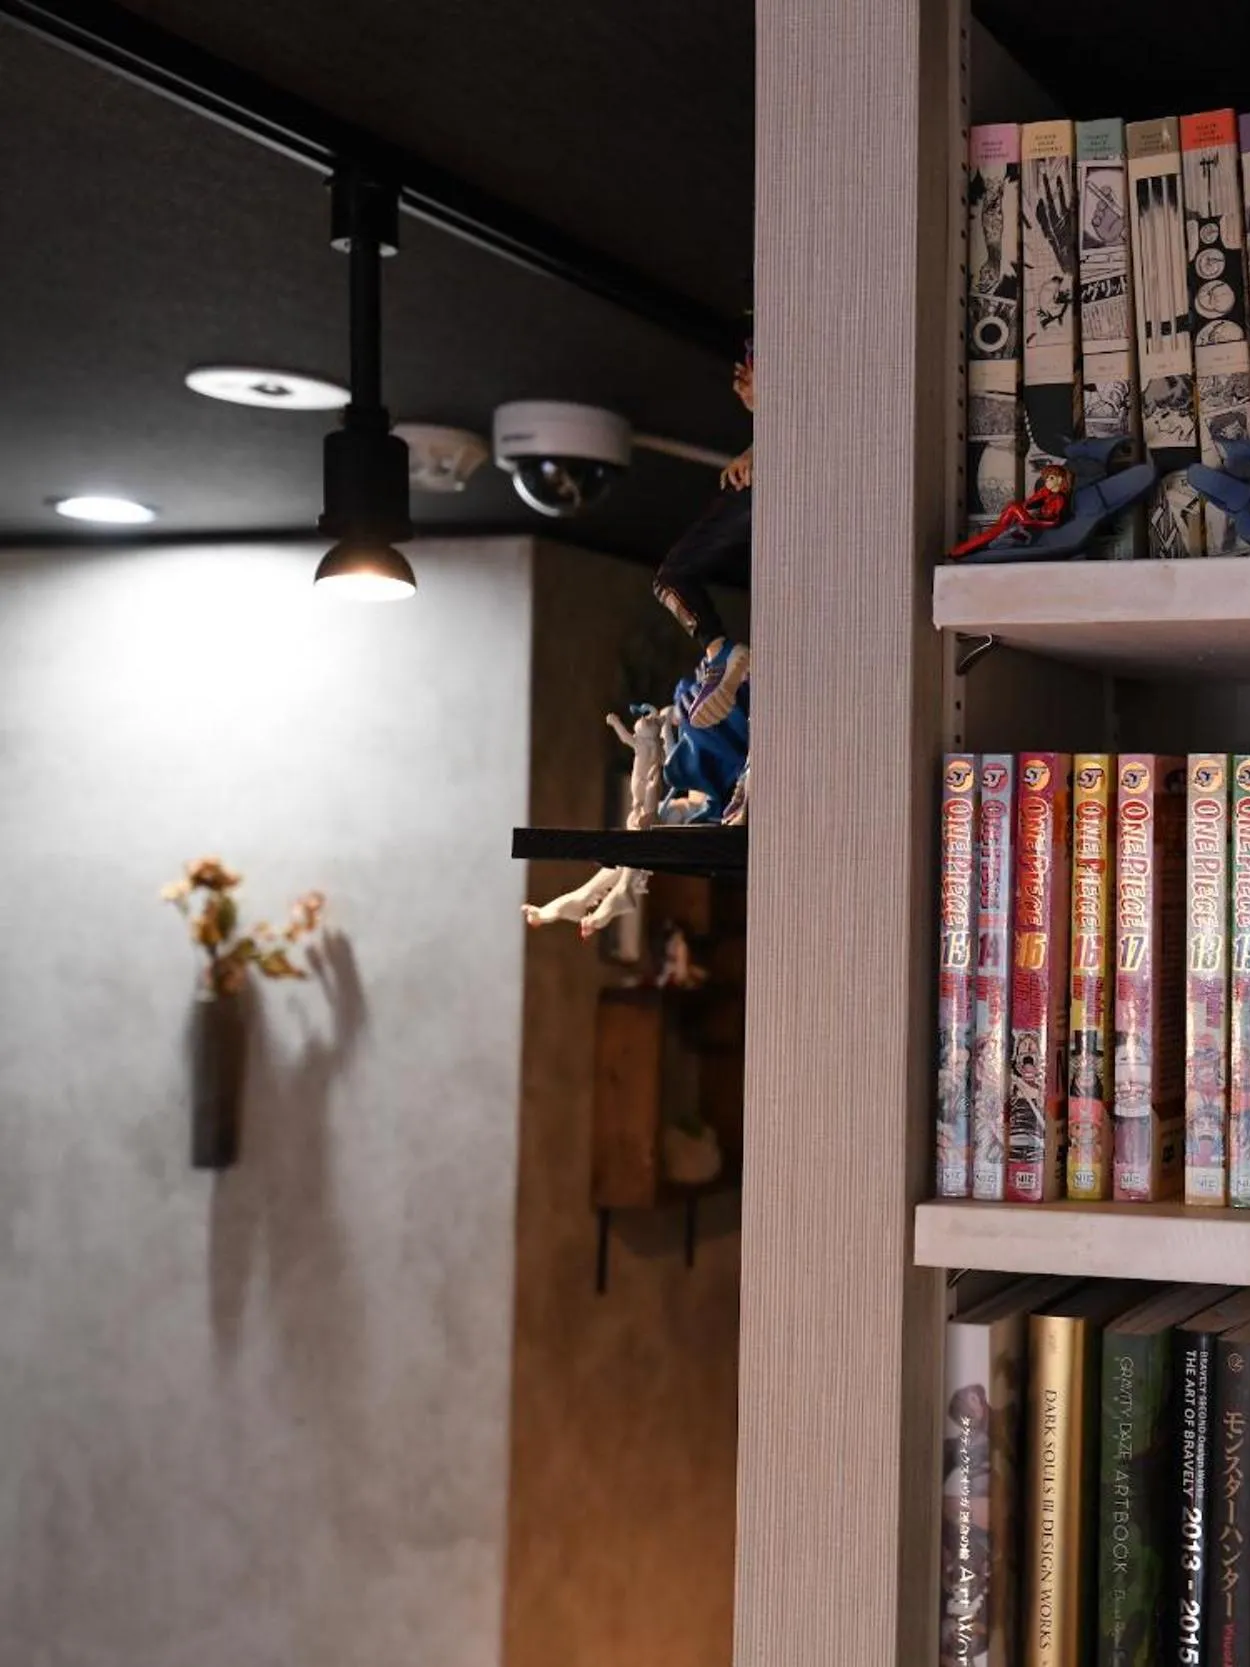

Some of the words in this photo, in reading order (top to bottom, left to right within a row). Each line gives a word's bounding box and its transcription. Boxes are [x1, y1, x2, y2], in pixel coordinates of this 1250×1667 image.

[943, 800, 973, 855] ONE
[1019, 797, 1049, 852] ONE
[1076, 801, 1106, 856] ONE
[1119, 800, 1151, 856] ONE
[1192, 798, 1222, 855] ONE
[941, 856, 972, 927] PIECE
[1018, 853, 1048, 926] PIECE
[1075, 858, 1106, 930] PIECE
[1119, 858, 1150, 928] PIECE
[1191, 856, 1222, 928] PIECE
[1119, 934, 1147, 970] 17
[1191, 933, 1221, 970] 18
[1184, 1378, 1196, 1404] ART
[1185, 1350, 1197, 1376] THE
[1041, 1389, 1058, 1437] DARK
[1183, 1408, 1195, 1427] OF
[1041, 1441, 1057, 1495] SOULS
[1119, 1423, 1132, 1461] DAZE
[1183, 1431, 1195, 1497] BRAVELY
[1041, 1499, 1055, 1513] III
[1112, 1470, 1129, 1574] ARTBOOK
[1219, 1412, 1246, 1618] モンスターハンター
[1039, 1519, 1055, 1583] DESIGN
[1179, 1506, 1203, 1570] 2013
[959, 1566, 977, 1609] Art
[1038, 1588, 1054, 1650] WORKS
[1178, 1598, 1200, 1665] 2015
